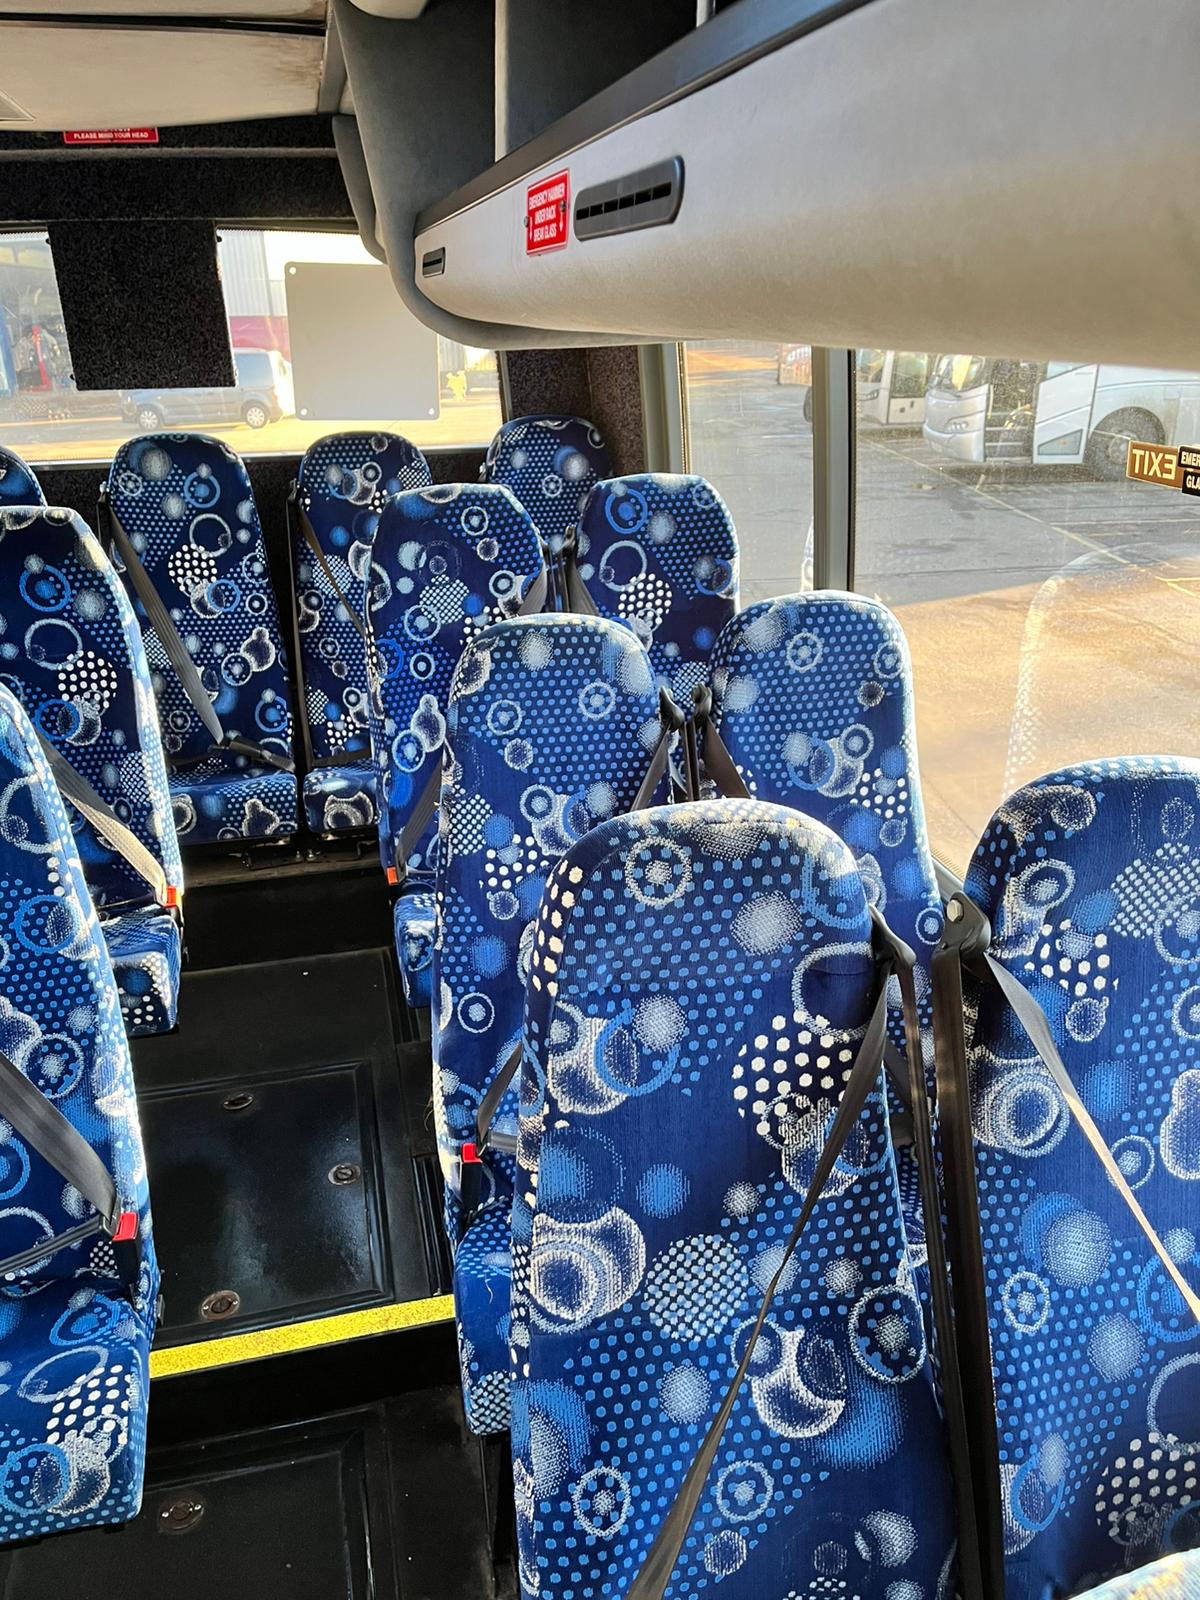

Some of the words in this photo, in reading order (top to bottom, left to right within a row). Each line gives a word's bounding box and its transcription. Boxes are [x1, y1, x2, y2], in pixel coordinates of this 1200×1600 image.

[73, 132, 97, 140] PLEASE
[131, 131, 149, 139] HEAD
[528, 191, 548, 210] EMERGENCY
[547, 182, 566, 202] HAMMER
[533, 227, 545, 243] BREAK
[544, 222, 557, 239] GLASS
